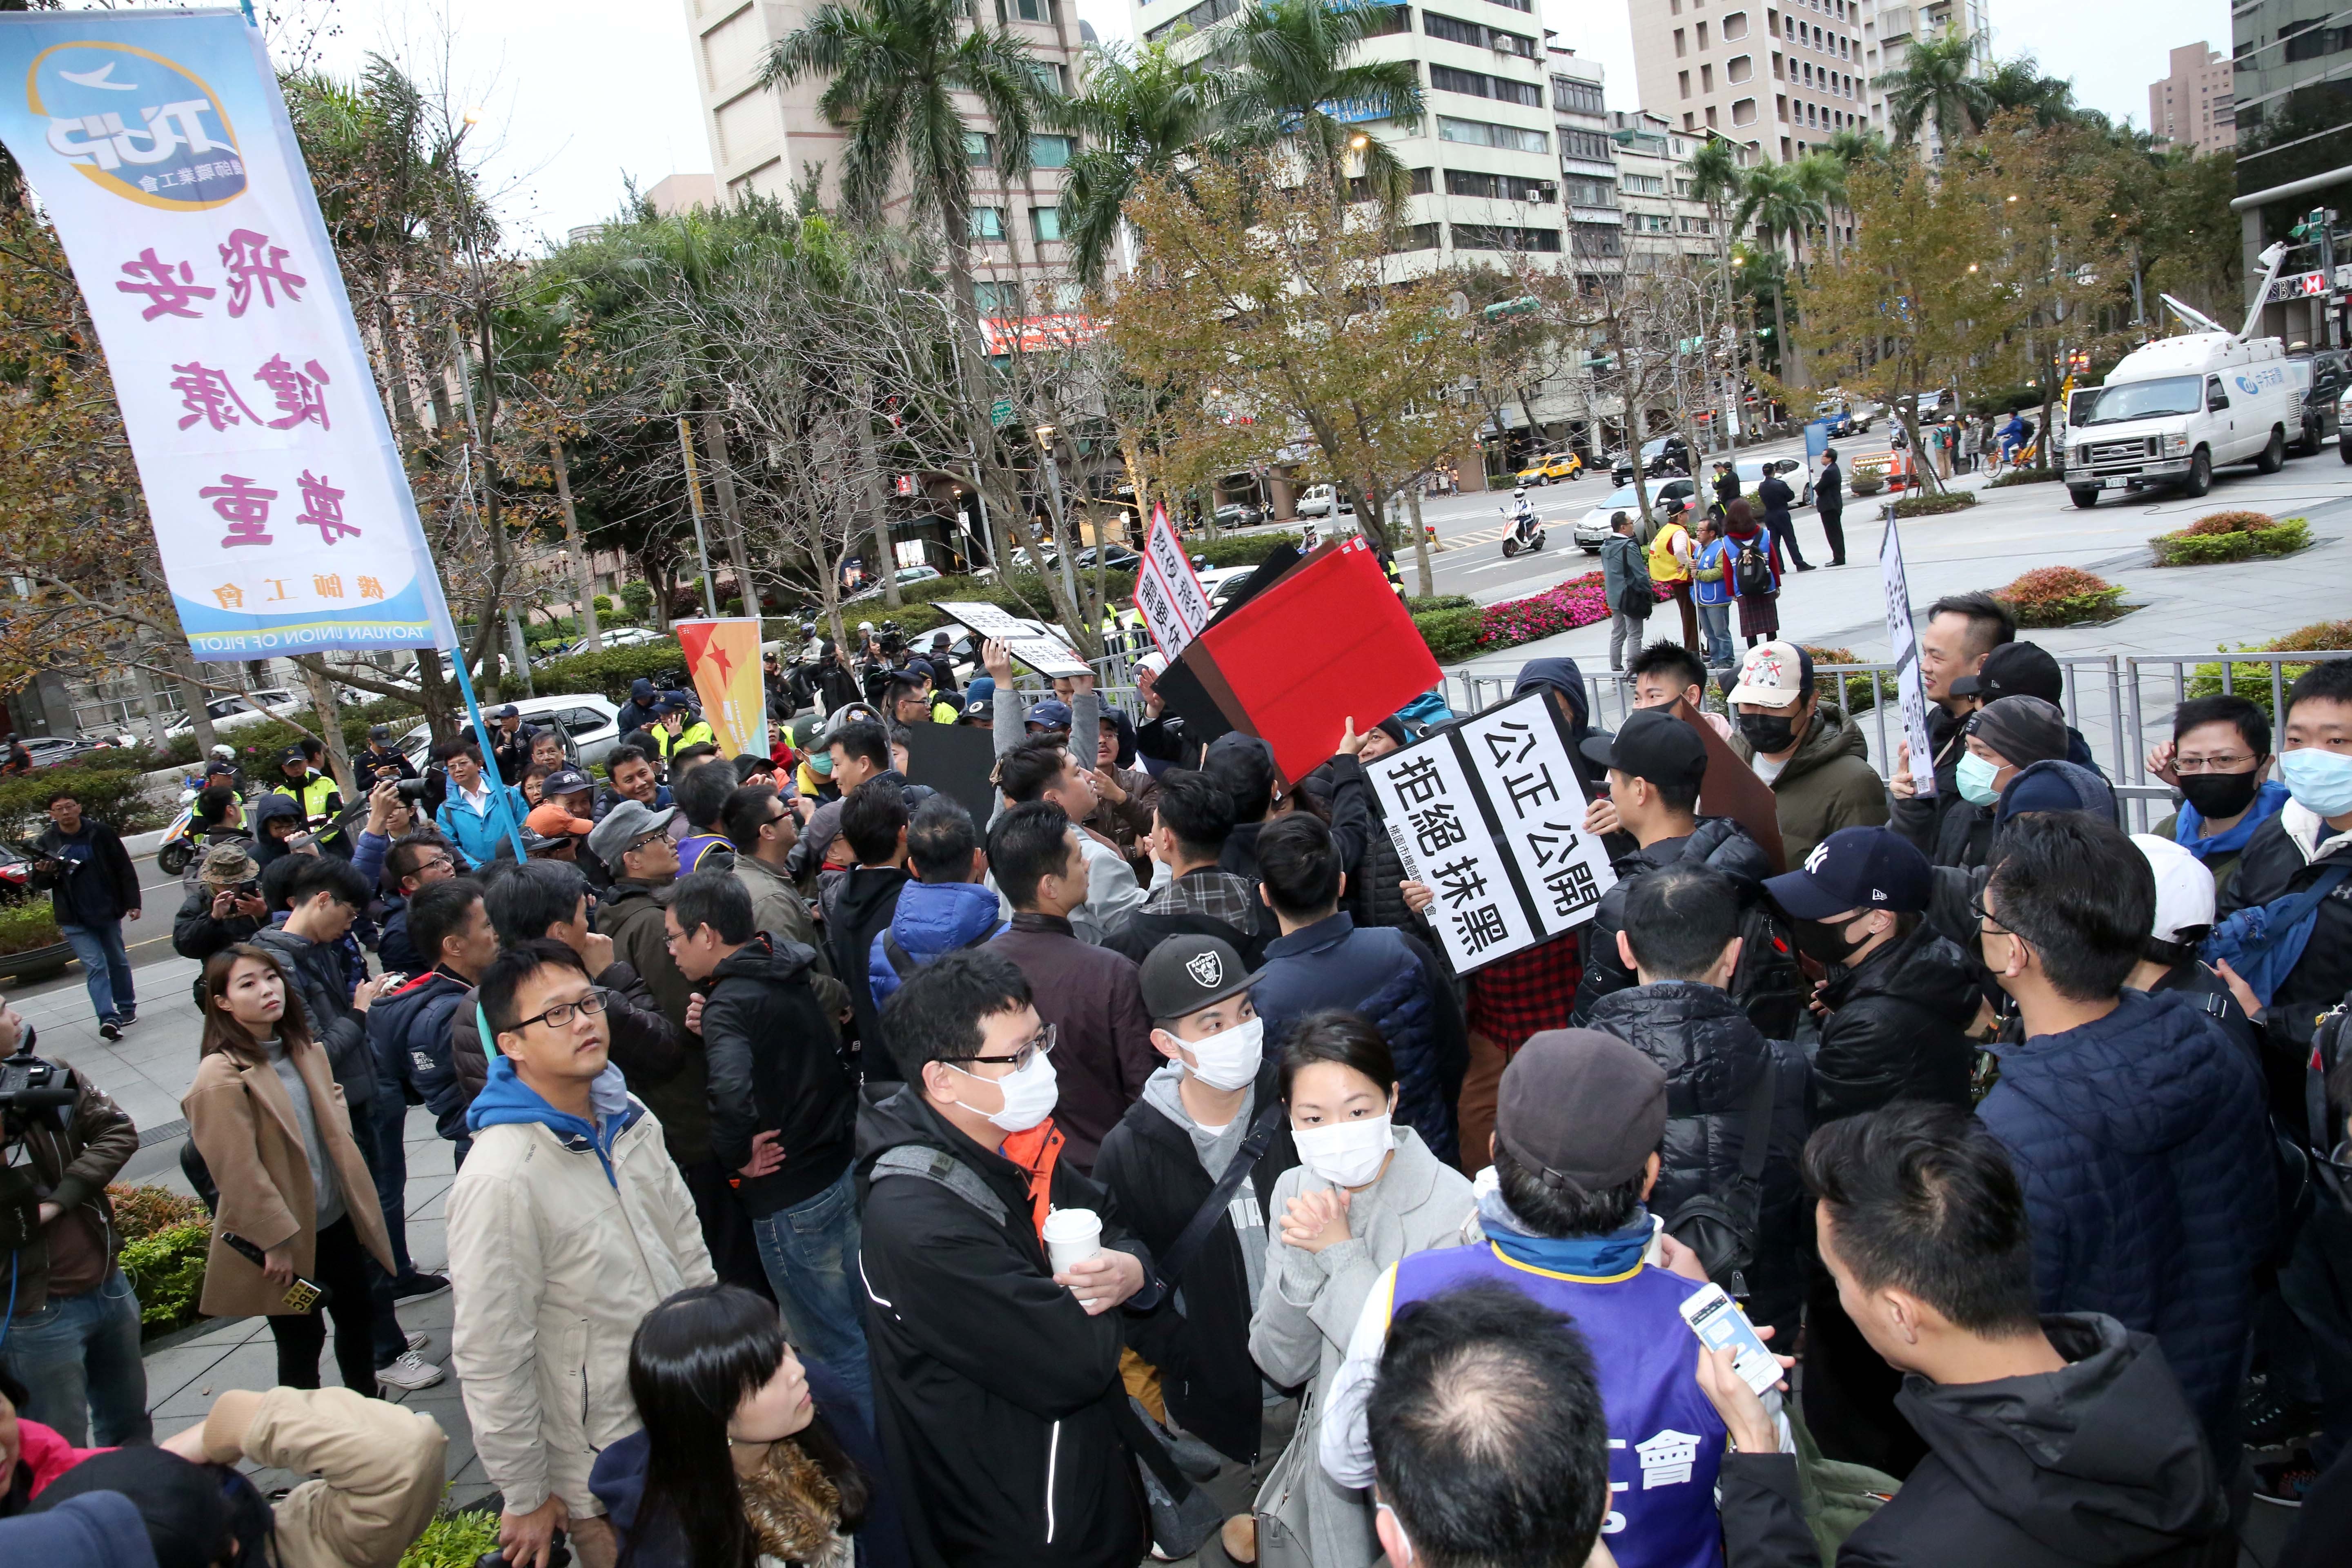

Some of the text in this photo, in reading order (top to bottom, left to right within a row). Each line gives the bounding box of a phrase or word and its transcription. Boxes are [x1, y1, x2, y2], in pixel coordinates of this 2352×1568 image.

[2266, 276, 2303, 301] SBC
[1387, 755, 1509, 956] 拒絕抹黑
[1483, 721, 1602, 917] 公正公開
[1389, 824, 1436, 916] 桃園市機師職會
[1192, 954, 1214, 968] RAIDERS
